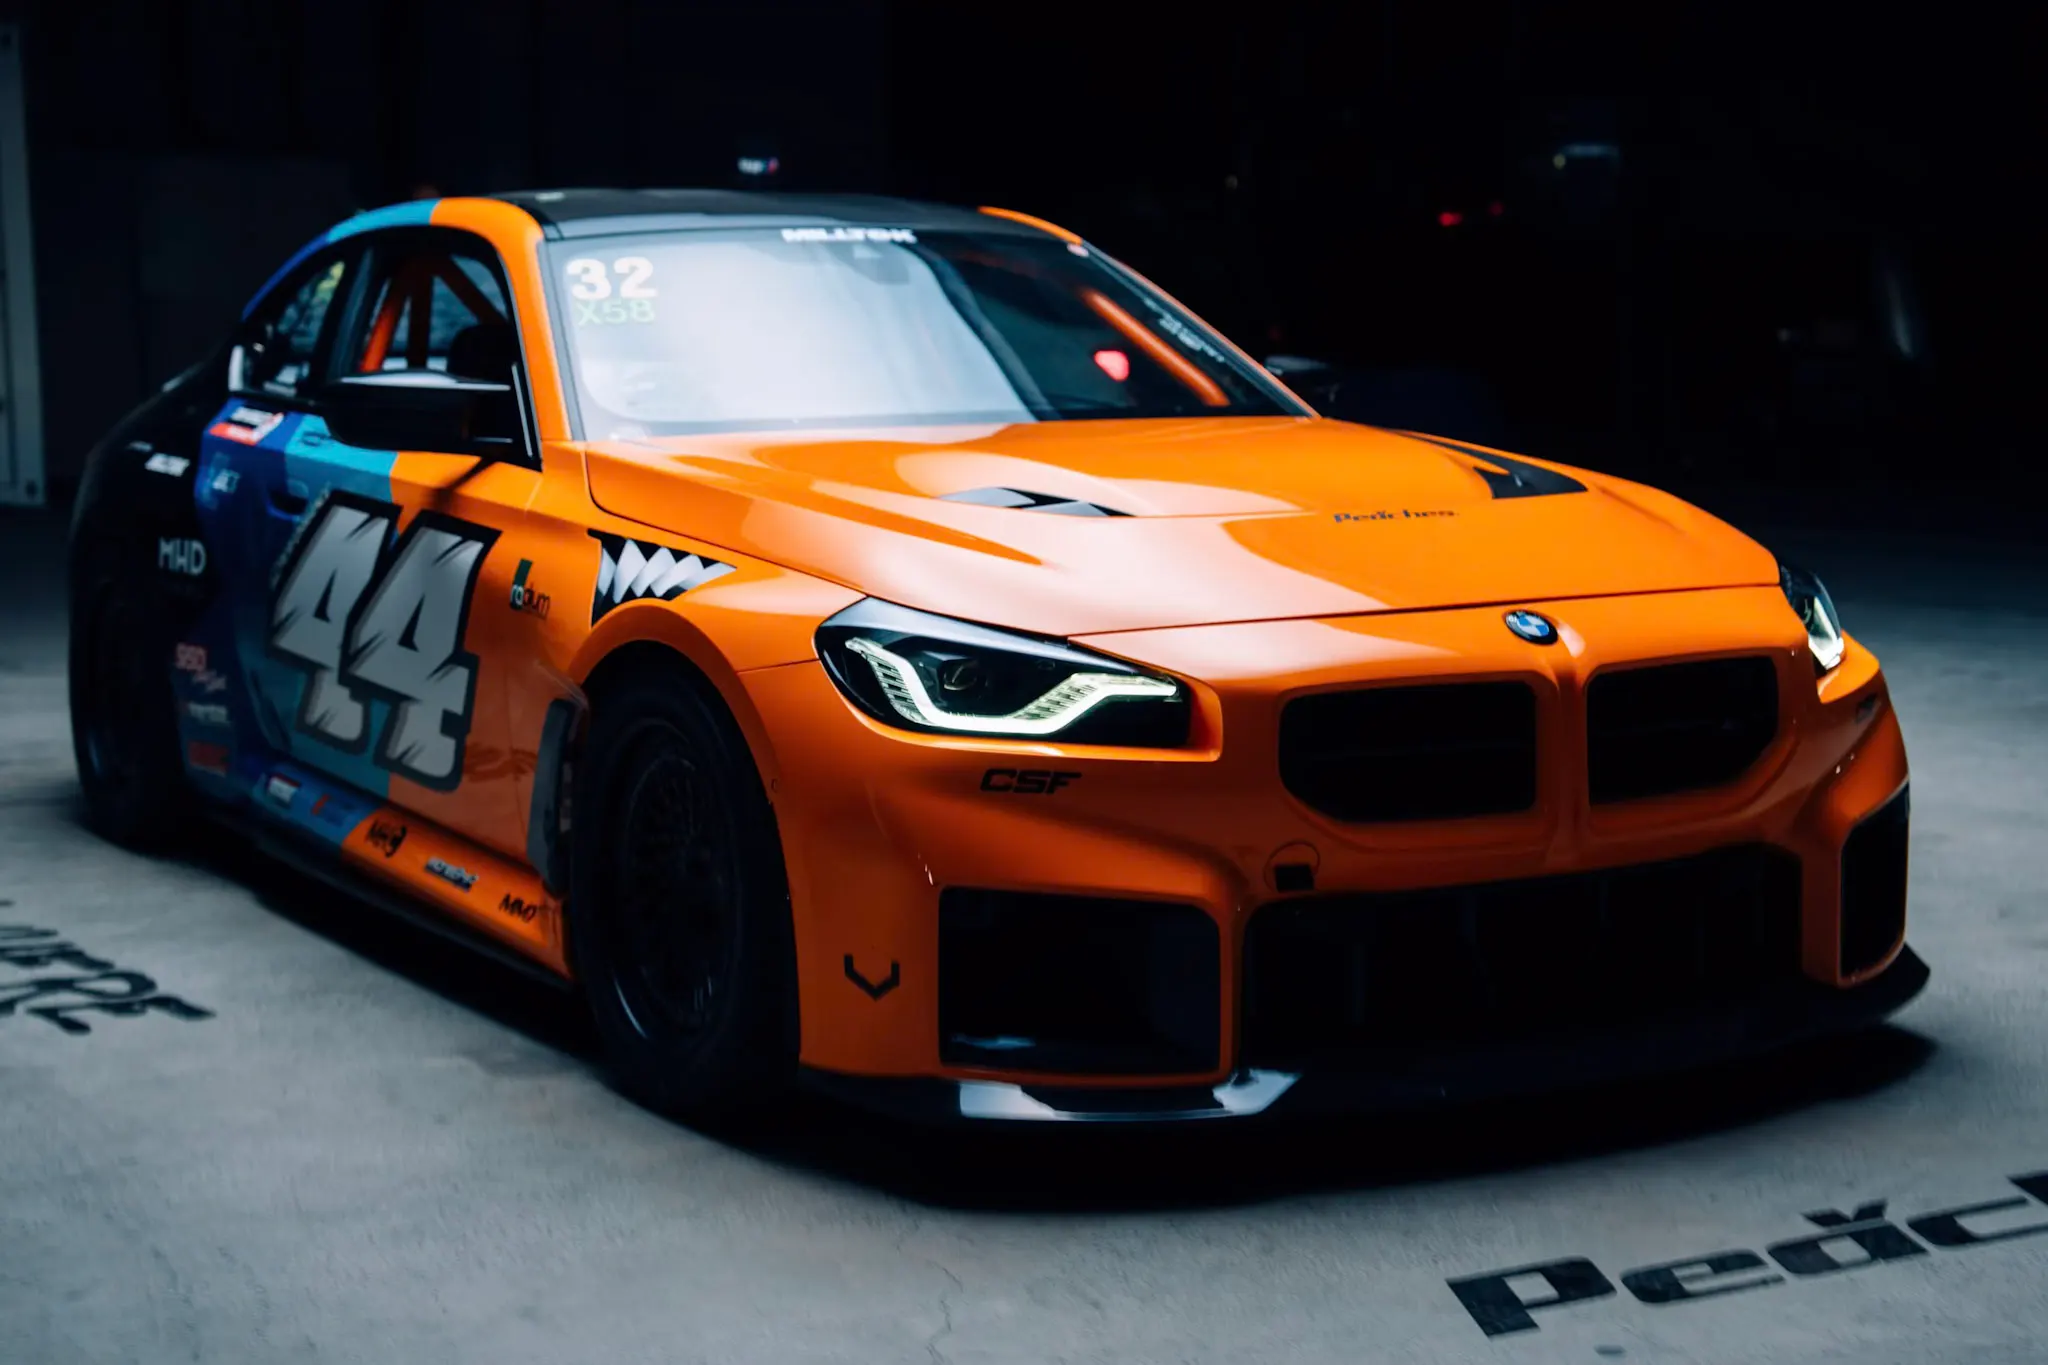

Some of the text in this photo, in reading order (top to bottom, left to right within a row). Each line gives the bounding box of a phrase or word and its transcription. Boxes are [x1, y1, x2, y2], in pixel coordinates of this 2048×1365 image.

[566, 256, 658, 300] 32
[267, 492, 500, 790] 44
[980, 769, 1082, 794] CSF
